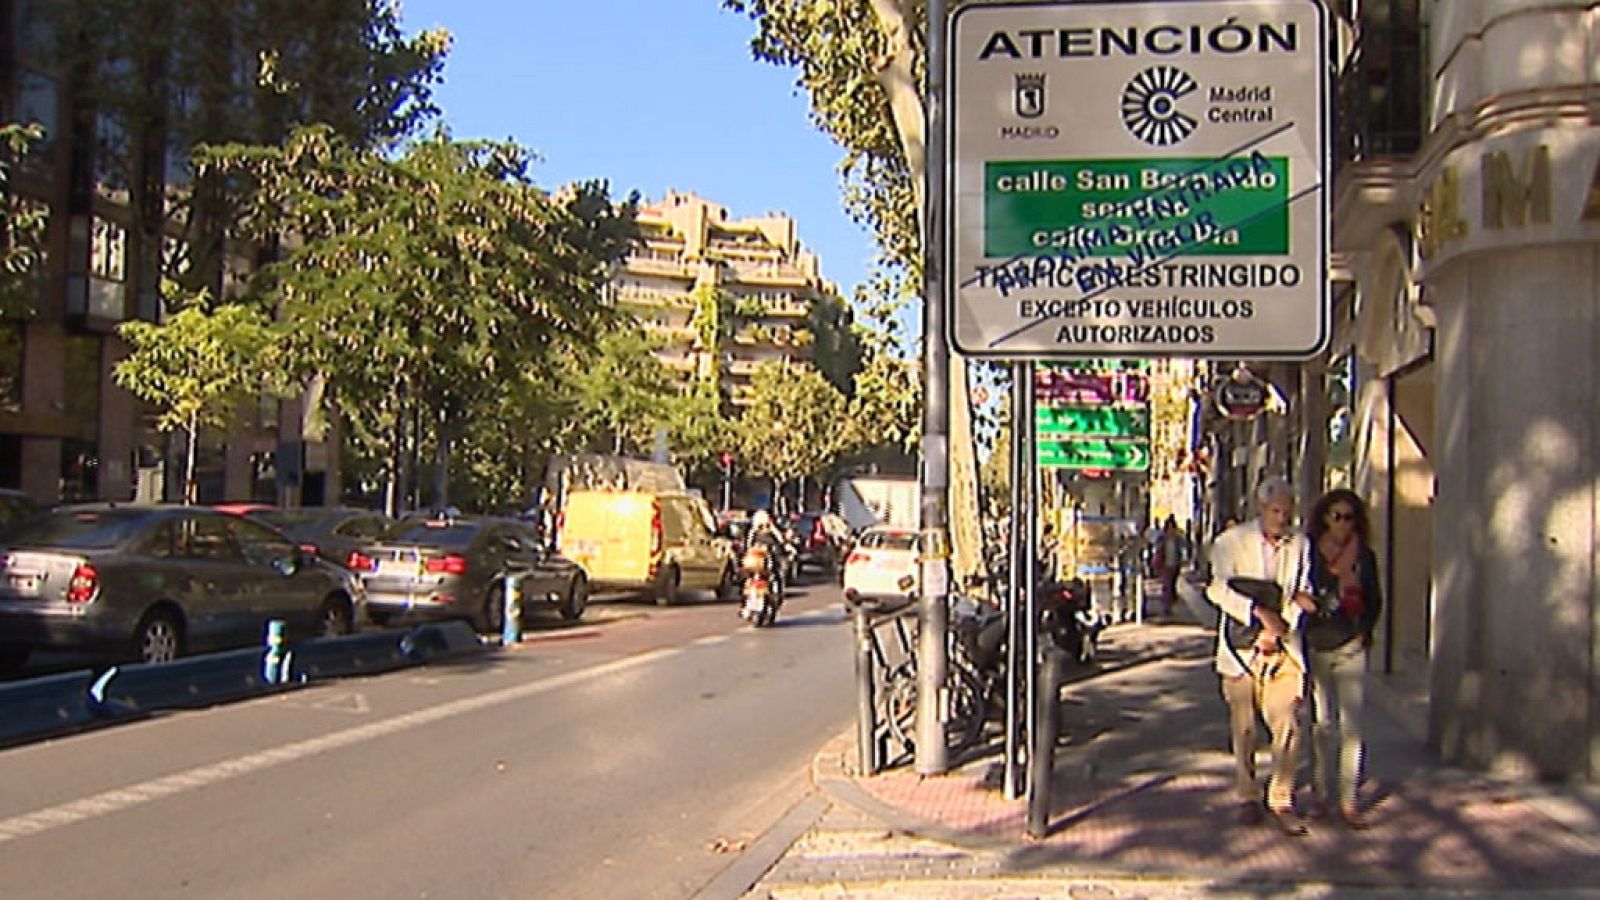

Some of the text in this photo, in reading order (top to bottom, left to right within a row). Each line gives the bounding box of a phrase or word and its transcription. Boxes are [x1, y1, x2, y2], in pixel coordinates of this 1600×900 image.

[978, 16, 1297, 61] ATENCIÓN
[1208, 86, 1272, 102] Madrid
[1207, 106, 1274, 123] Central
[996, 170, 1067, 191] calle
[1076, 169, 1130, 190] San
[1109, 264, 1301, 288] RESTRINGIDO
[1020, 296, 1254, 318] EXCEPTO VEHÍCULOS
[1057, 324, 1215, 344] AUTORIZADOS
